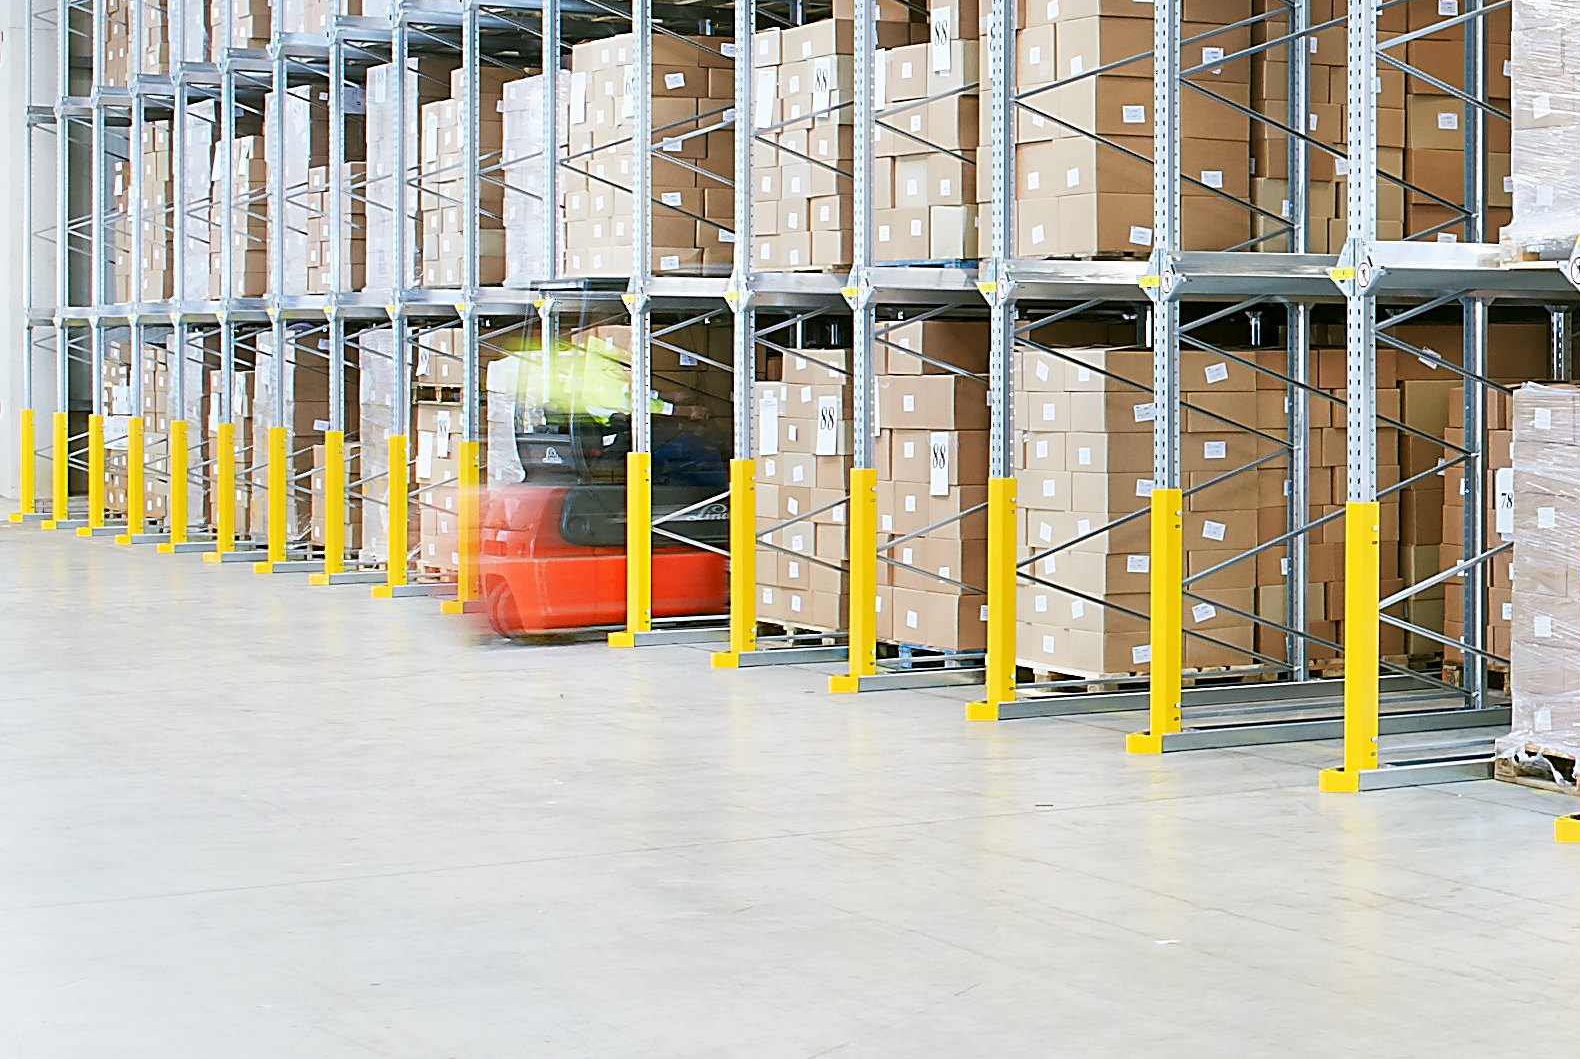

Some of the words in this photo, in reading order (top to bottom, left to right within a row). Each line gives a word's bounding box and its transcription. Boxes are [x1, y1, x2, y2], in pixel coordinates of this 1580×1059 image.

[933, 19, 948, 46] 88
[814, 67, 829, 92] 88
[820, 406, 835, 431] 88
[932, 443, 946, 469] 88
[1500, 491, 1514, 510] 78
